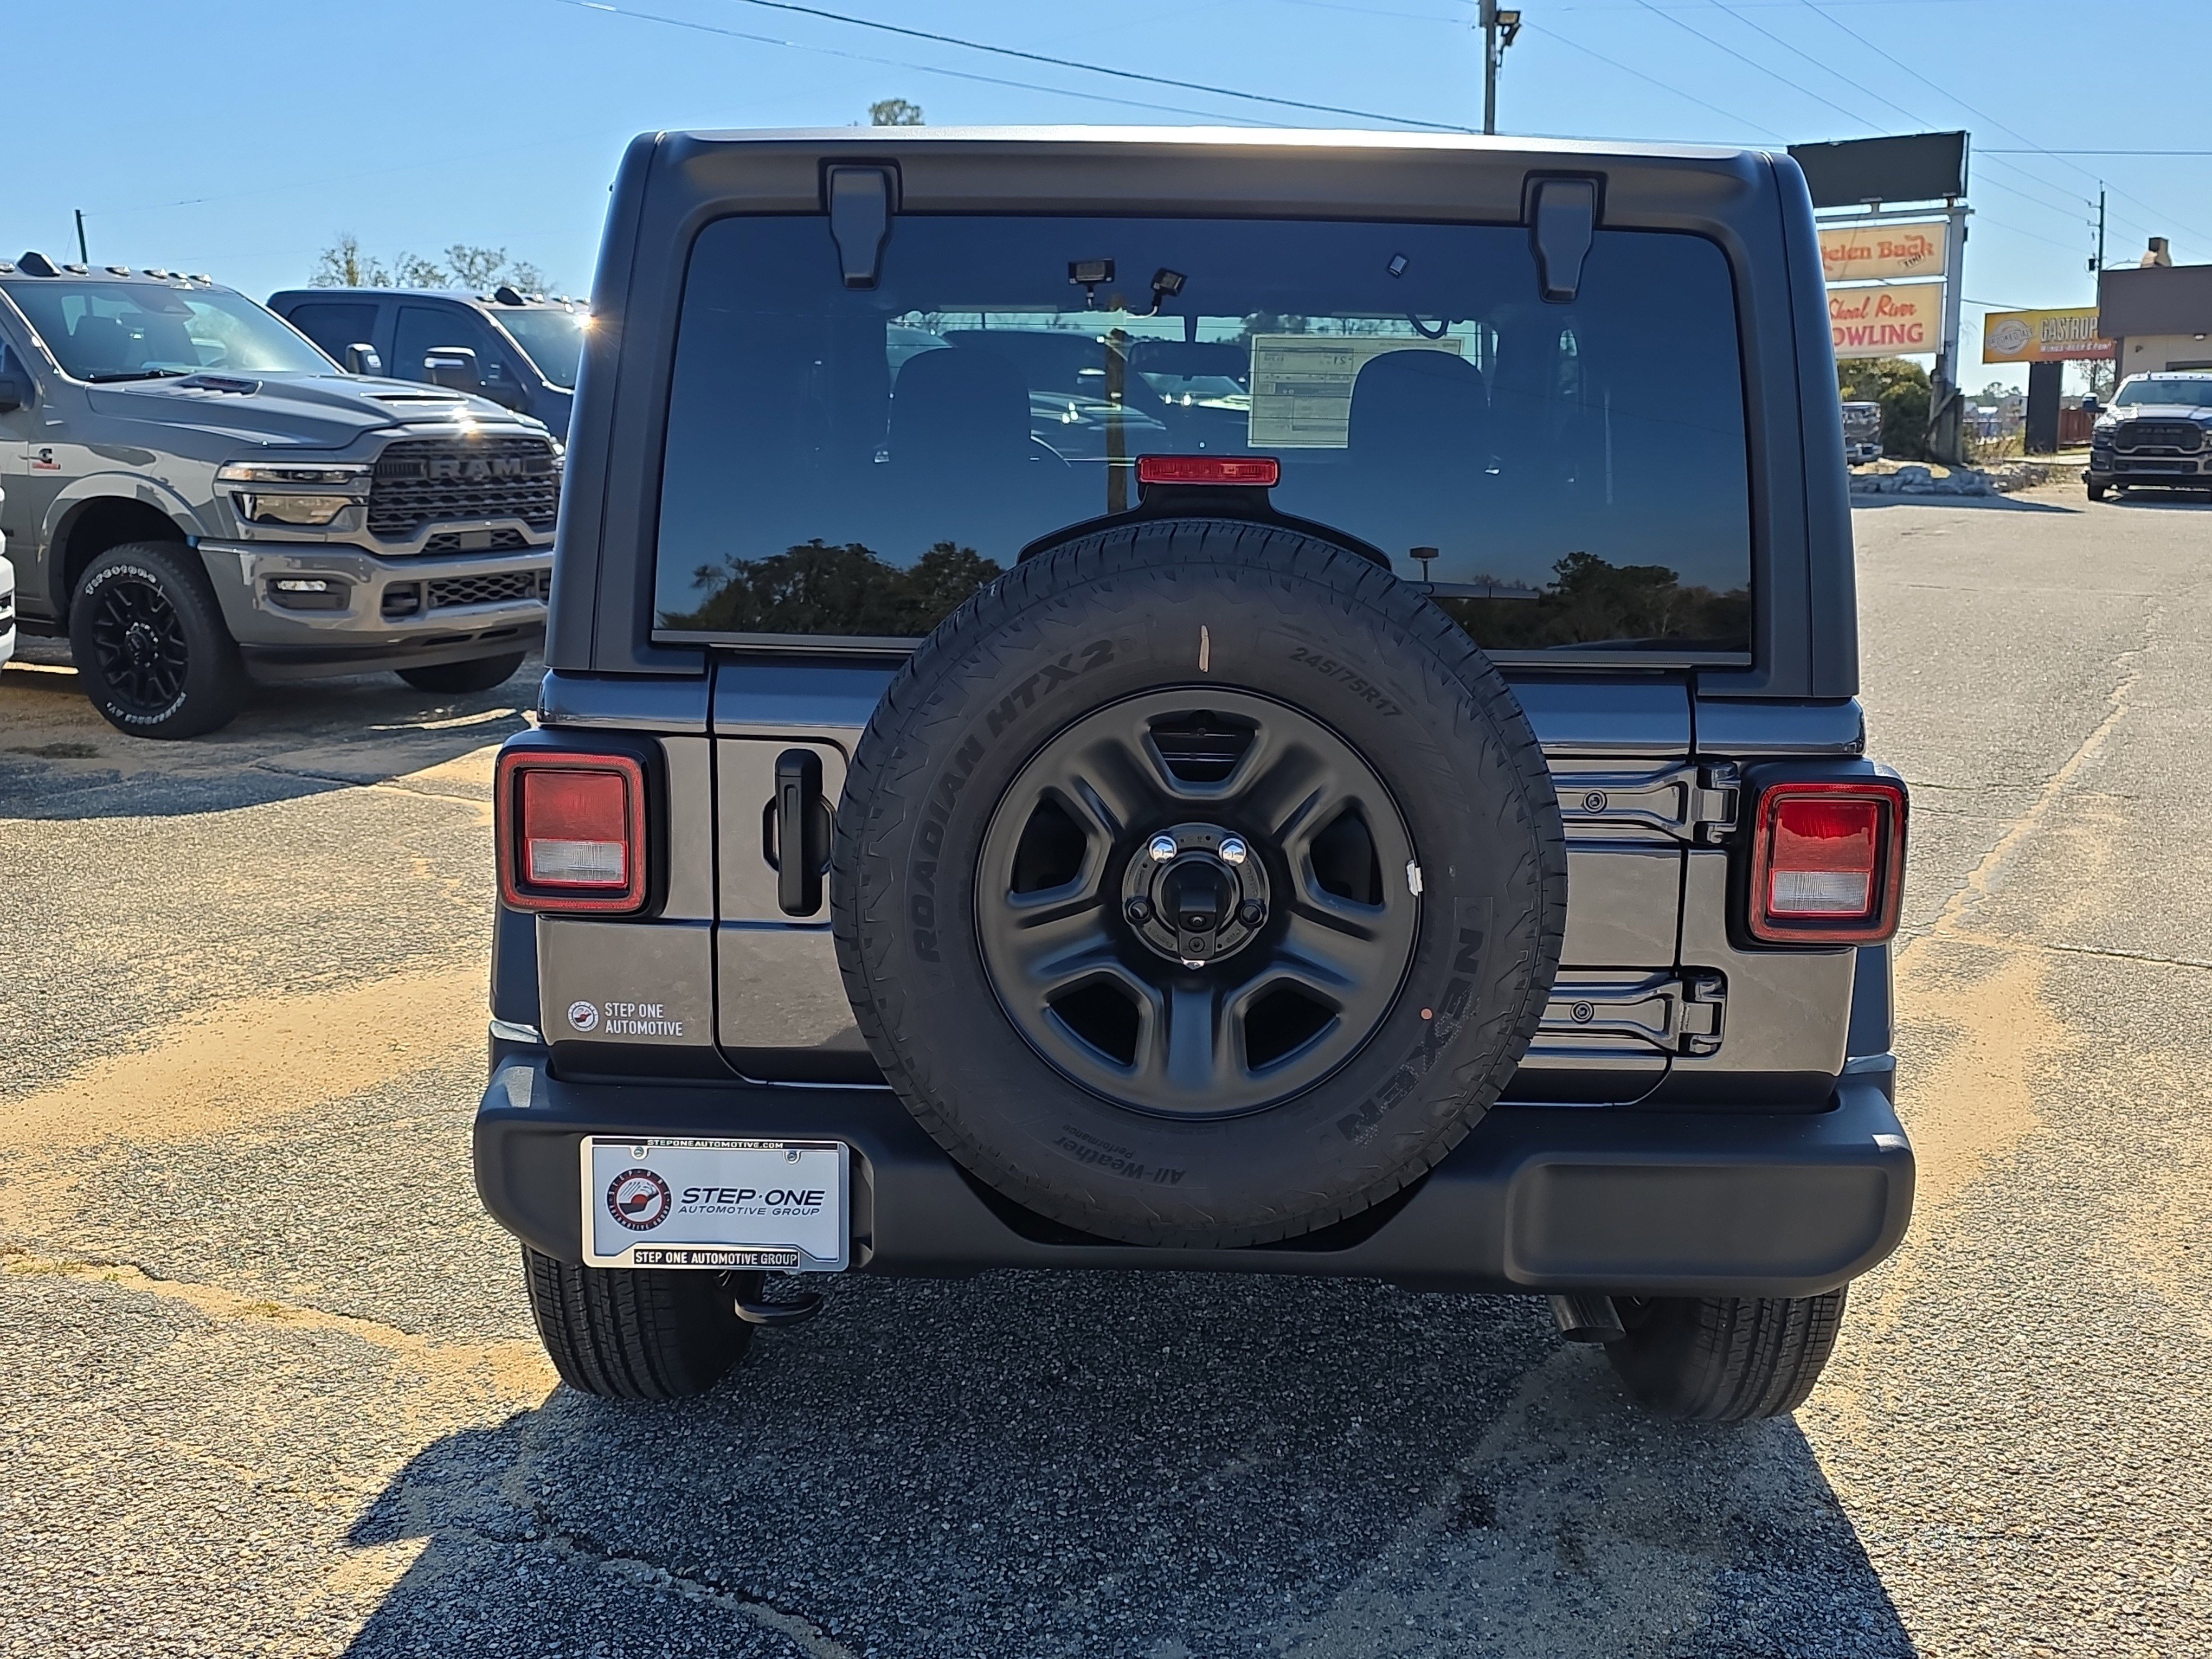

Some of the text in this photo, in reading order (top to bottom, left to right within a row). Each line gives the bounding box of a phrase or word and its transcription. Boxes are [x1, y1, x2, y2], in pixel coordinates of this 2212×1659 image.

[1877, 235, 1935, 259] Back
[1875, 294, 1917, 318] River
[429, 459, 521, 479] RAM
[1289, 646, 1403, 717] 245/75R17
[605, 1002, 635, 1018] STEP
[639, 1004, 665, 1018] ONE
[605, 1019, 683, 1037] AUTOMOTIVE
[1336, 928, 1481, 1143] NEXEN
[647, 1140, 784, 1149] STEPONEAUTOMOTIVE.COM
[1062, 1123, 1135, 1160] Performance
[1052, 1136, 1187, 1186] All-Weather
[678, 1206, 820, 1216] AUTOMOTIVE GROUP
[635, 1251, 798, 1265] STEP ONE AUTOMOTIVE GROUP
